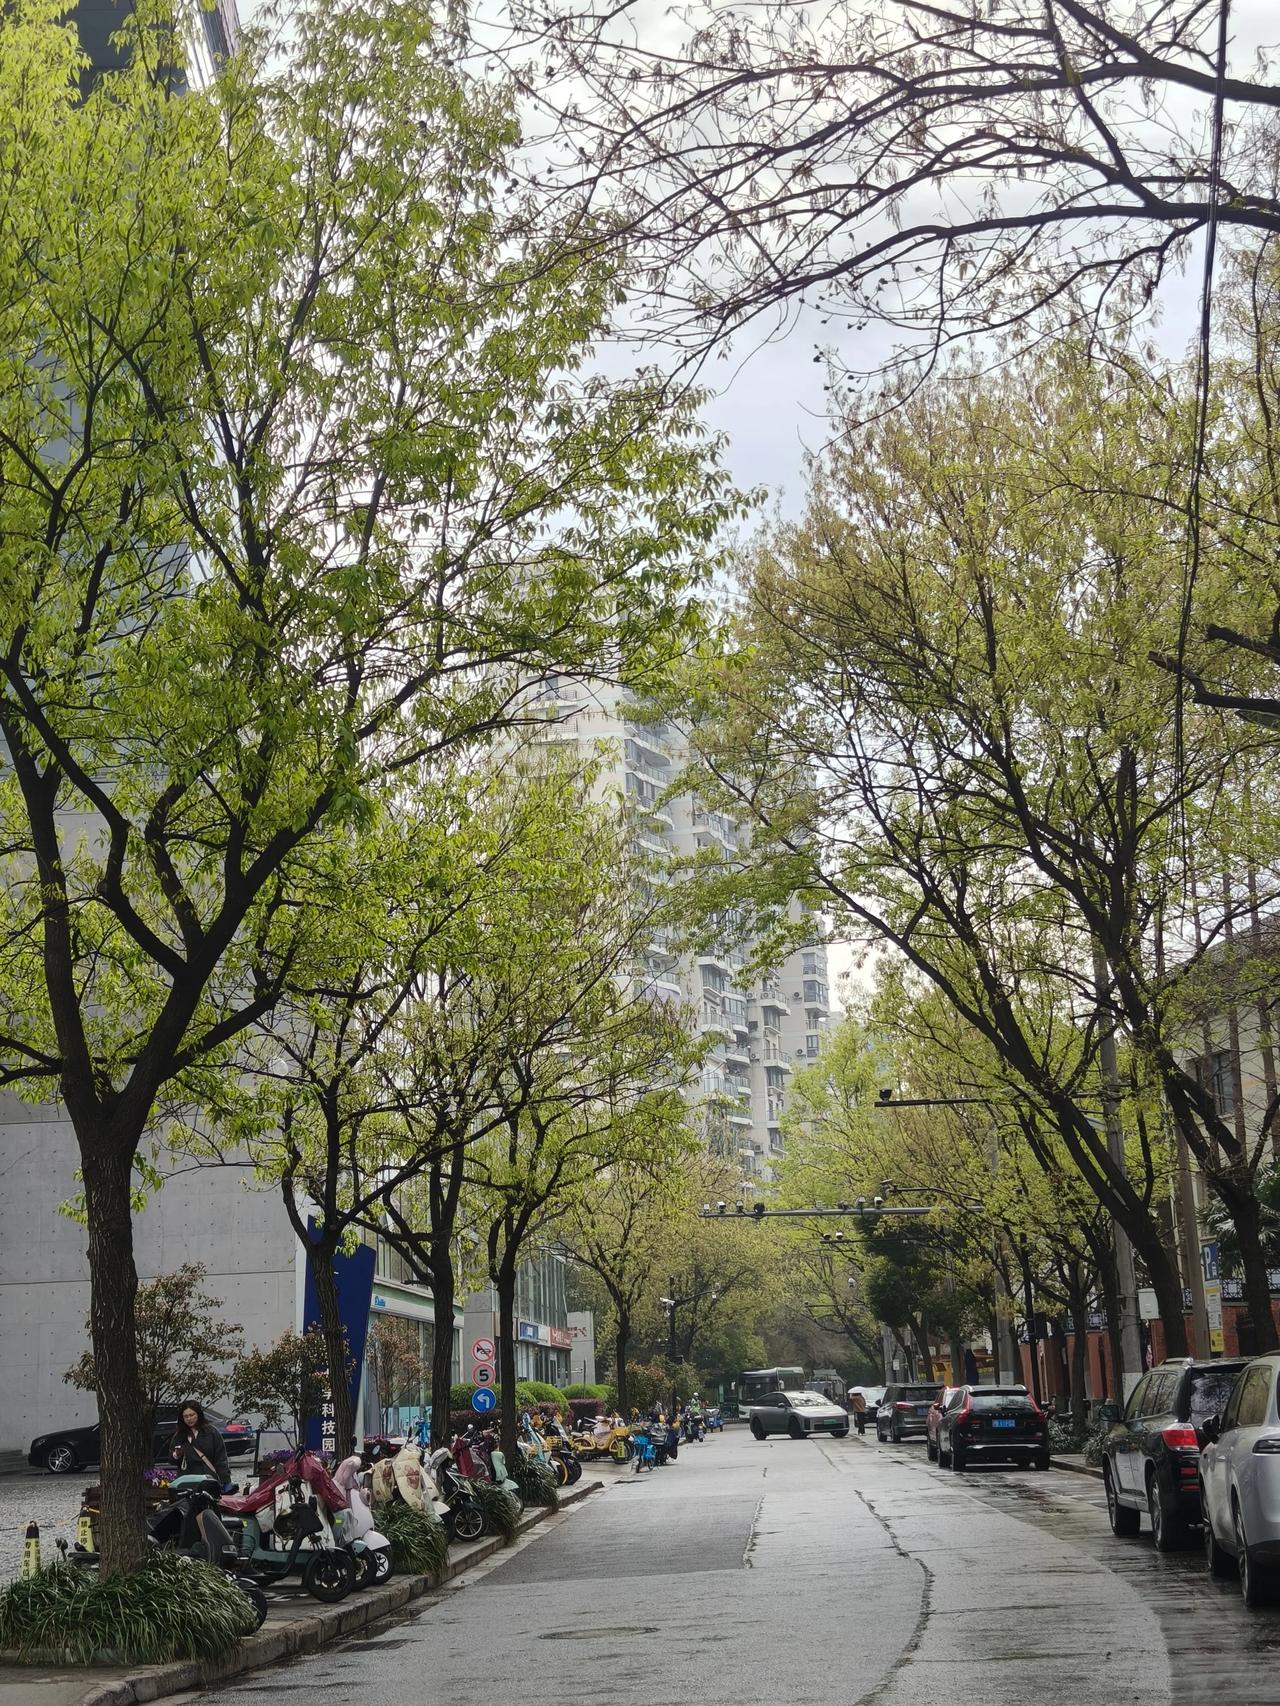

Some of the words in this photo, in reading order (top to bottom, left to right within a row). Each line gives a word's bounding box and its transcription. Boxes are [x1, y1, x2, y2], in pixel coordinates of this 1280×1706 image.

[479, 1369, 489, 1382] 5
[80, 1520, 88, 1546] 禁止停
